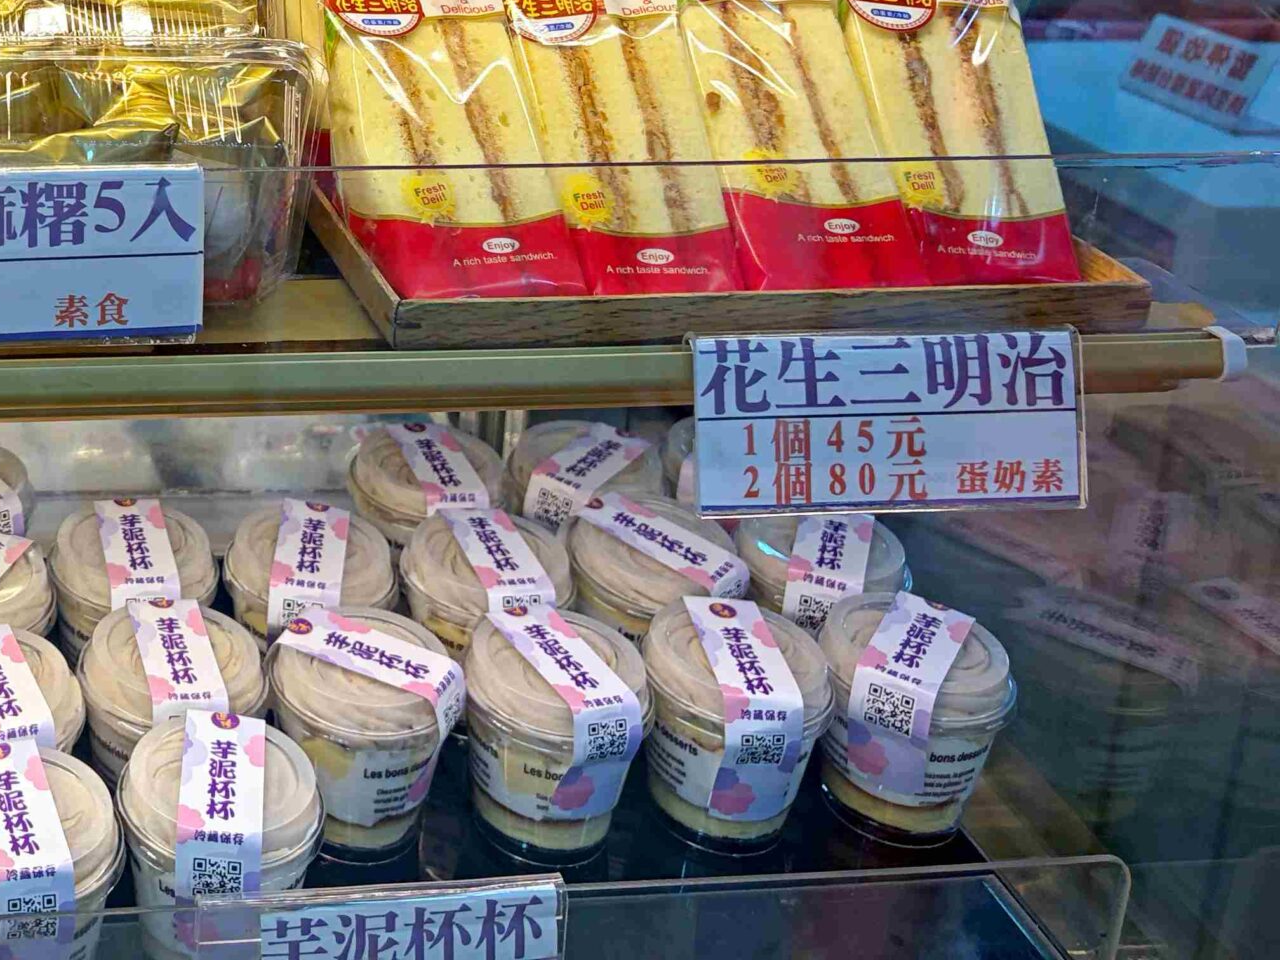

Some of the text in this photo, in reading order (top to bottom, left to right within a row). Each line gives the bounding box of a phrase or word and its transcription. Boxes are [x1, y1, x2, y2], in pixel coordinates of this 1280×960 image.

[441, 4, 495, 15] Delicious
[622, 4, 677, 16] Delicious
[414, 182, 446, 198] Fresh
[573, 190, 605, 203] Fresh
[421, 193, 446, 206] Deli!
[579, 200, 605, 211] Deli!
[827, 221, 856, 232] Enjoy
[486, 240, 516, 252] Enjoy
[463, 257, 481, 266] rich
[484, 255, 507, 264] taste
[640, 252, 671, 262] Enjoy
[616, 265, 633, 274] rich
[636, 265, 660, 274] taste
[53, 292, 130, 328] 素食
[699, 332, 1067, 415] 花生三明治
[956, 458, 1065, 495] 蛋奶素
[119, 514, 153, 571] 芋泥杯杯
[296, 517, 326, 574] 芋泥杯杯
[468, 516, 520, 572] 芋泥杯杯
[892, 612, 942, 669] 芋泥杯杯
[156, 617, 199, 685] 芋泥杯杯
[523, 624, 600, 690] 芋泥杯杯
[720, 627, 774, 696] 芋泥杯杯
[929, 751, 956, 763] bons
[523, 764, 542, 778] Les
[206, 740, 237, 821] 芋泥杯杯
[194, 829, 245, 845] 冷藏保存
[261, 894, 543, 960] 芋泥杯杯
